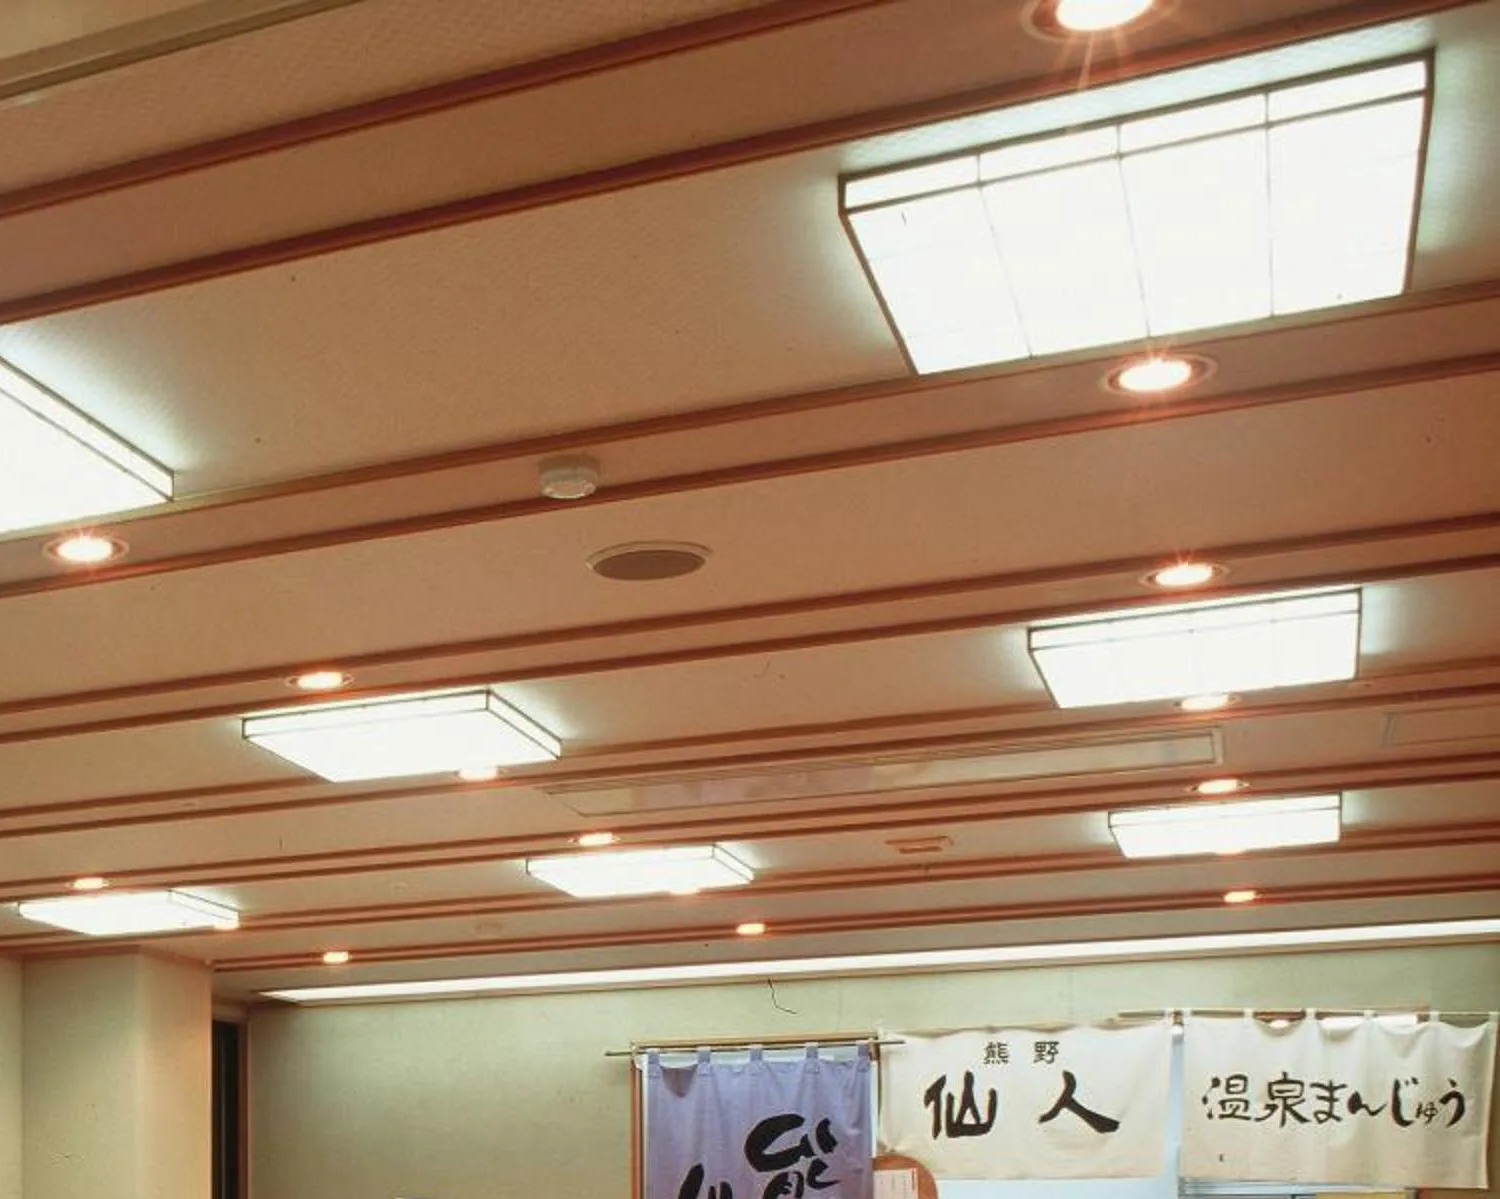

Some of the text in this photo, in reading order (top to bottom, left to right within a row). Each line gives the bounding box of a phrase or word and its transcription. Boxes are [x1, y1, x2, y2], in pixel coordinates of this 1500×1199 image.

[984, 1040, 1060, 1065] 熊野
[923, 1069, 1121, 1140] 仙人
[1202, 1071, 1467, 1128] 温泉まんじゅう
